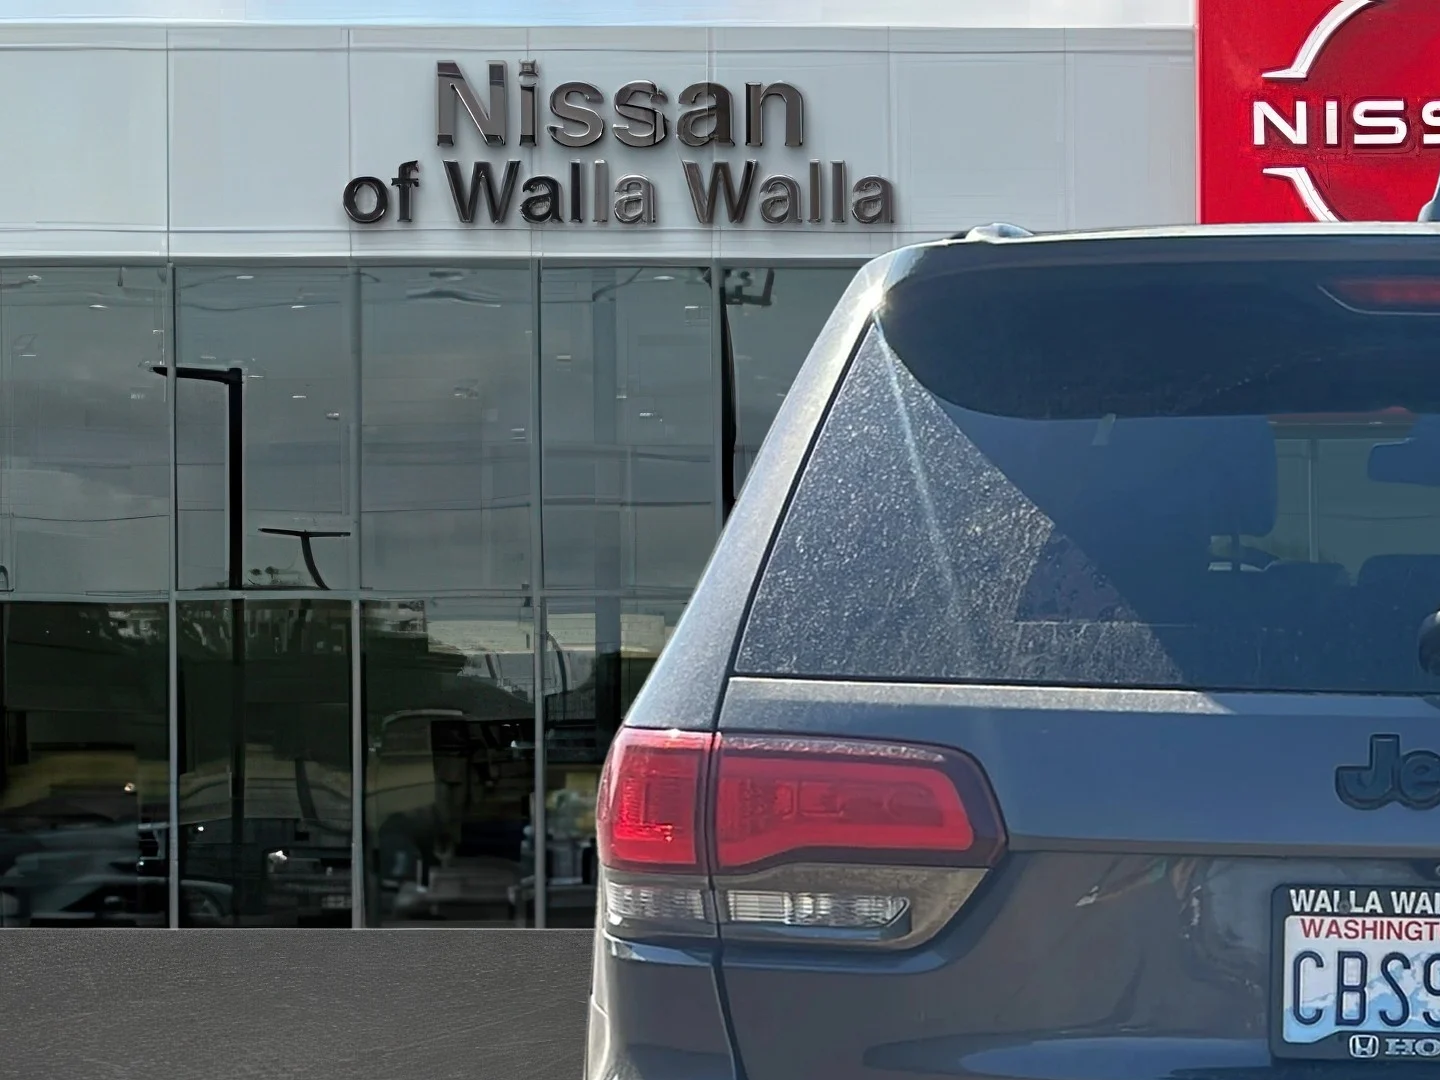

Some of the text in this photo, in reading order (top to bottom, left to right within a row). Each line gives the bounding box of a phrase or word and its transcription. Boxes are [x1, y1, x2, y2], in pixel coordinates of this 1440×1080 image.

[436, 59, 804, 147] Nissan
[342, 159, 895, 224] of Walla Walla
[1289, 889, 1383, 913] WALLA
